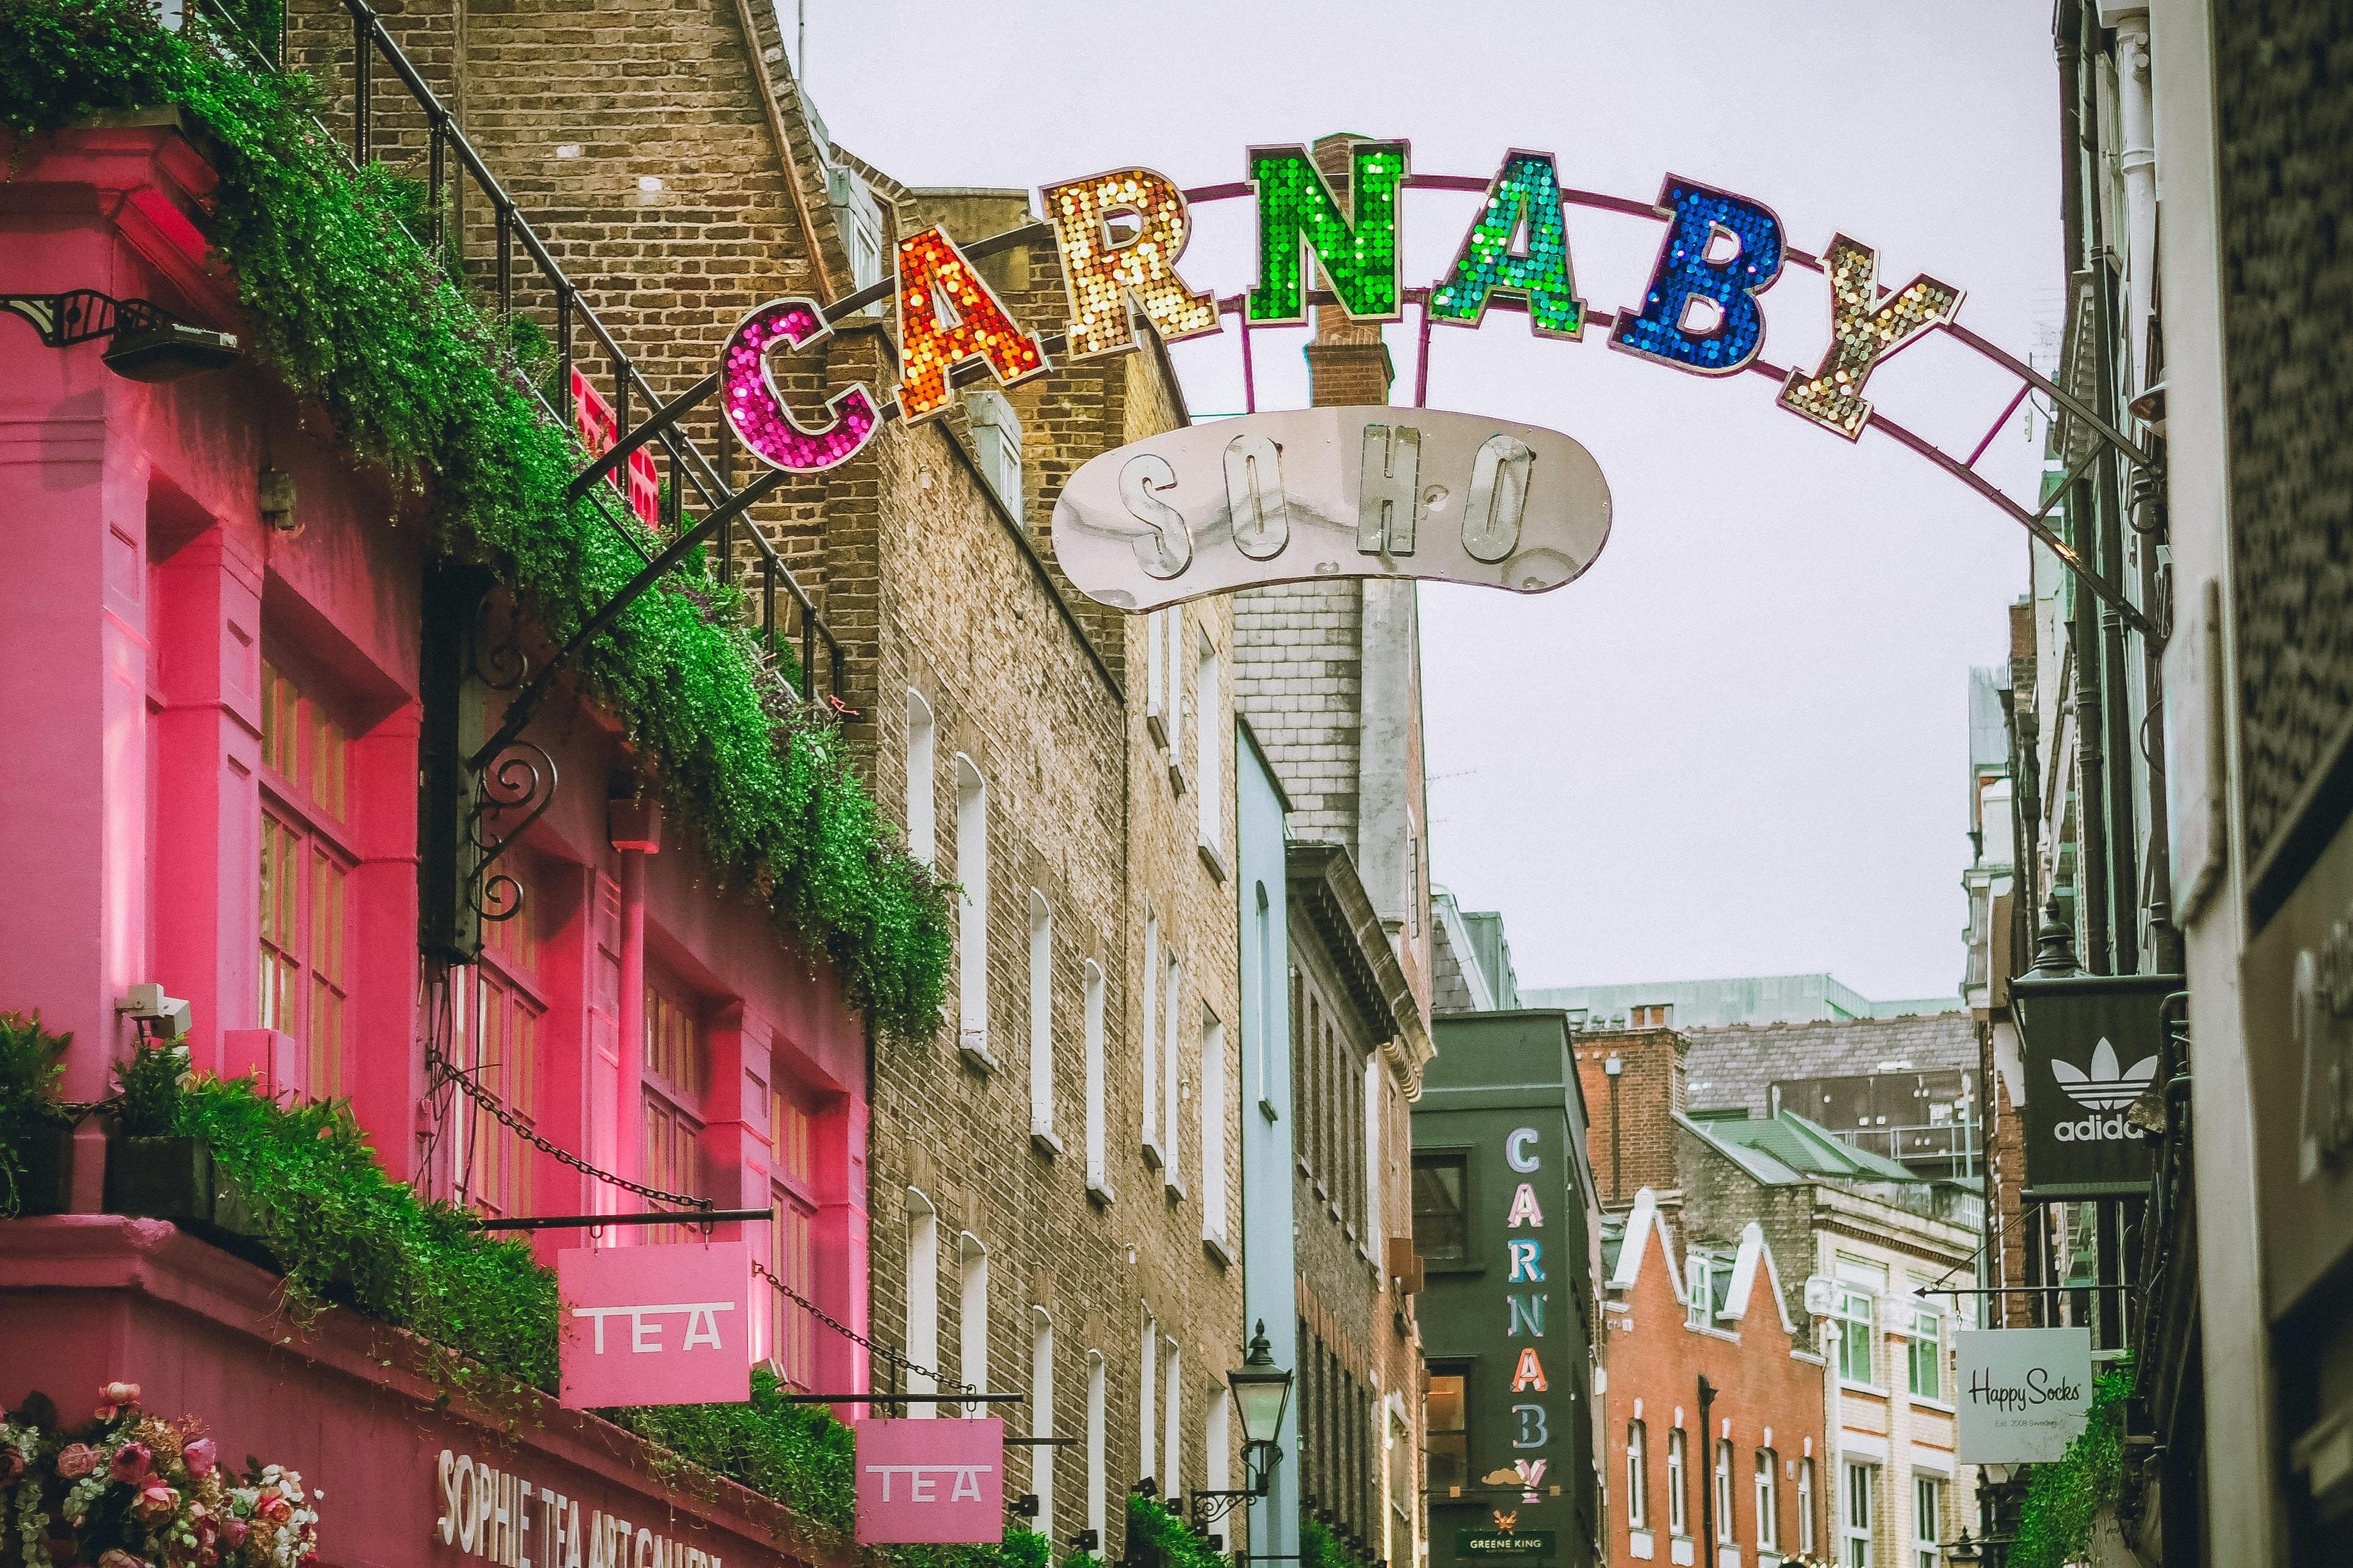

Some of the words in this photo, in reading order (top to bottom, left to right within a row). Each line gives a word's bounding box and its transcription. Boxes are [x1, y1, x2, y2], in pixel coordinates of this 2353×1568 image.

[718, 139, 1966, 474] CARNABY
[1119, 424, 1536, 580] SOHO
[2054, 1114, 2144, 1142] adida
[572, 1301, 735, 1355] TEA
[1506, 1127, 1548, 1504] CARNABY
[1968, 1367, 2027, 1412] Happy
[2026, 1368, 2080, 1405] Socks
[437, 1450, 531, 1568] SOPHIE
[541, 1488, 581, 1568] TEA
[866, 1465, 992, 1503] TEA
[1470, 1539, 1511, 1549] GREENE
[1515, 1540, 1542, 1548] KING
